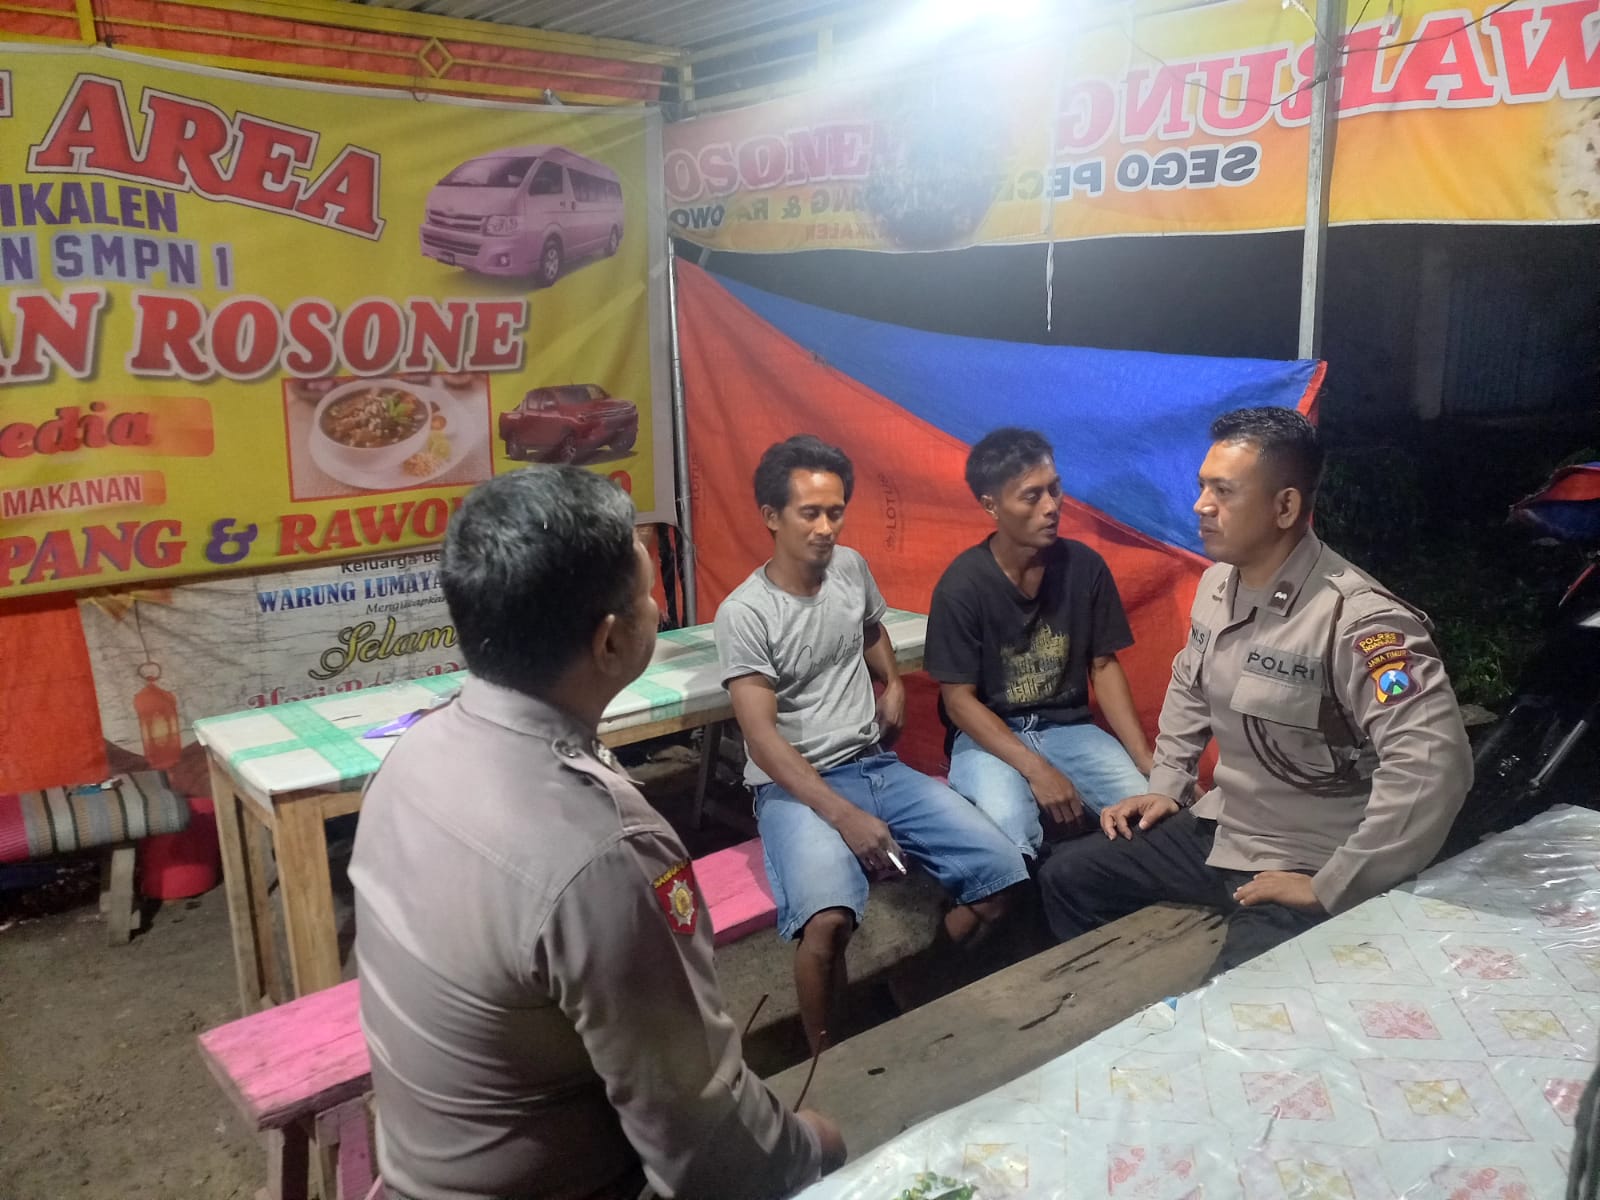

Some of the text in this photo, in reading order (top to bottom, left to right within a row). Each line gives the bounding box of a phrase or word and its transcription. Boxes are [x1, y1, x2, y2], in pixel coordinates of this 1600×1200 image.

[27, 73, 386, 241] AREA
[55, 234, 197, 285] SMPN
[215, 246, 230, 287] 1
[0, 290, 527, 381] N ROSONE
[3, 476, 142, 517] MAKANAN
[0, 519, 187, 588] PANG
[205, 518, 258, 565] &
[257, 581, 356, 613] WARUNG
[308, 615, 458, 681] Selam
[1247, 652, 1316, 682] POLRI
[1367, 655, 1386, 668] JAWA
